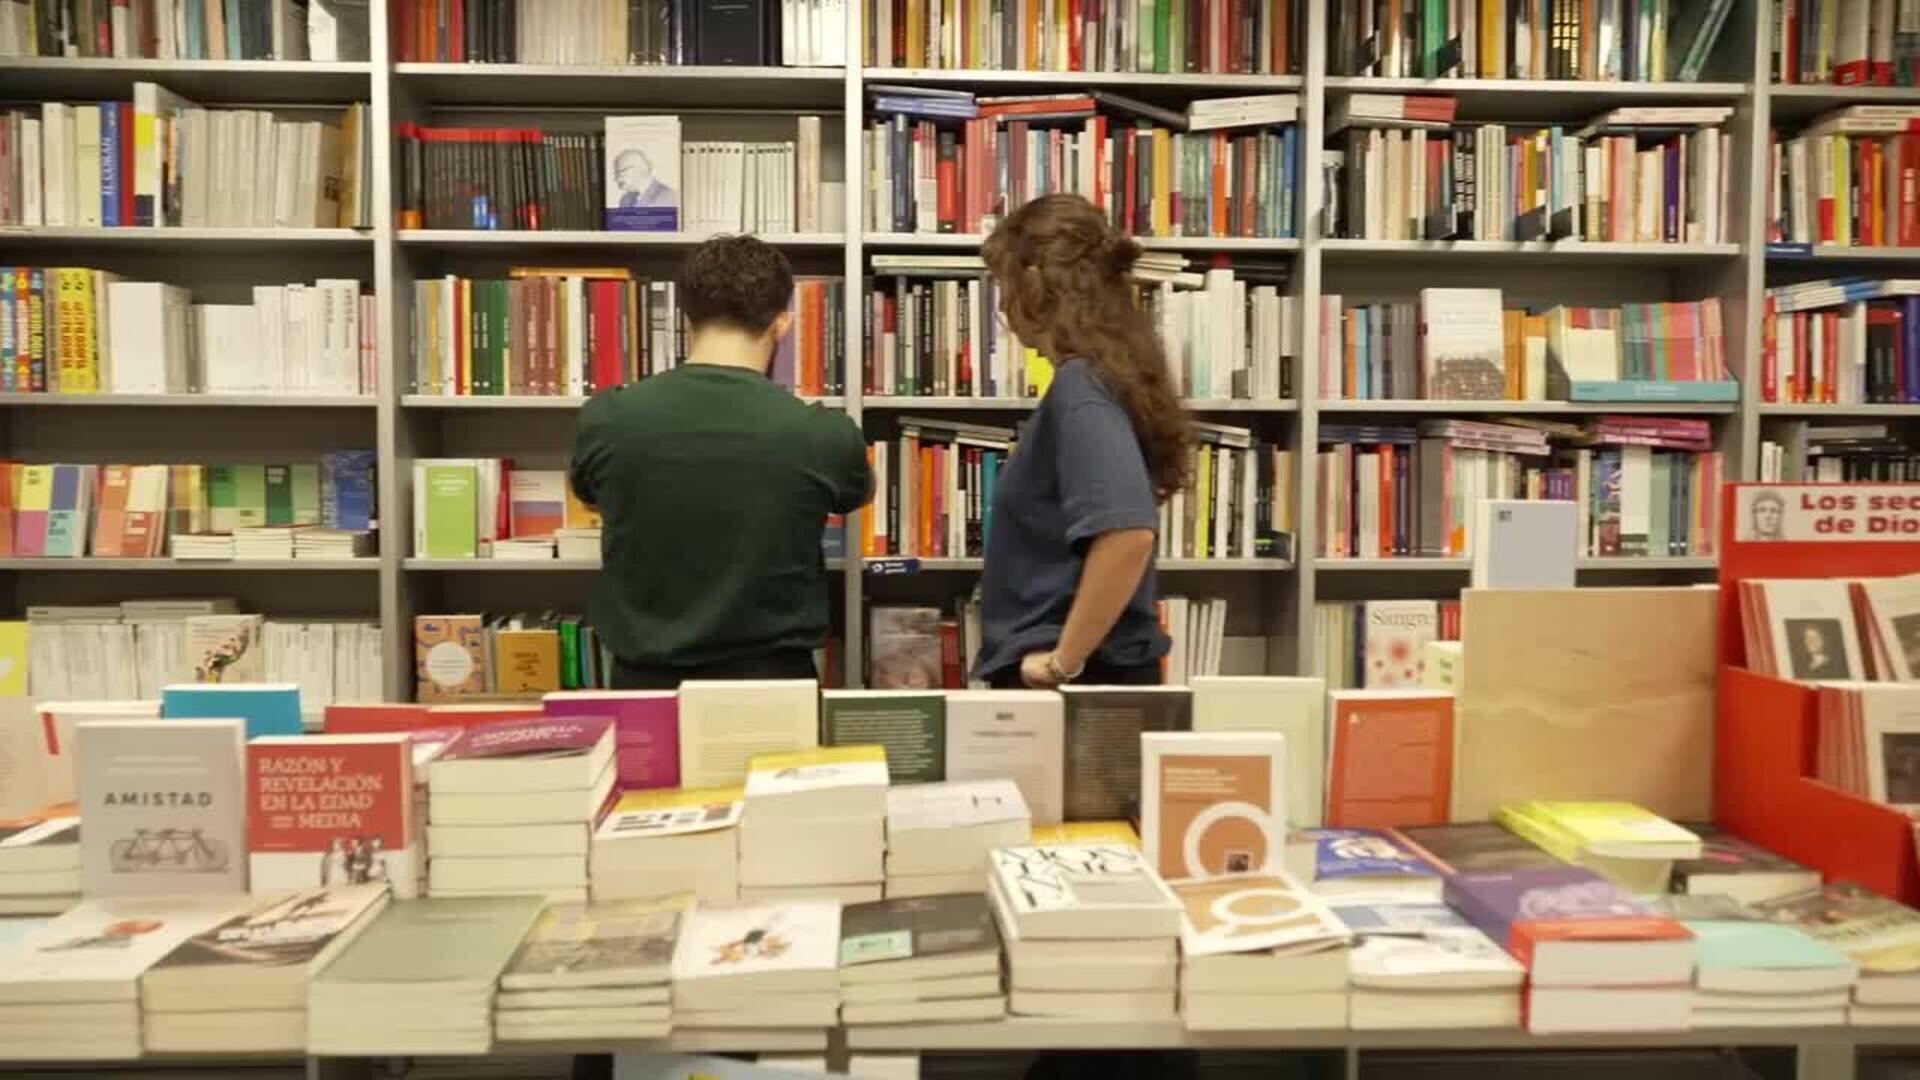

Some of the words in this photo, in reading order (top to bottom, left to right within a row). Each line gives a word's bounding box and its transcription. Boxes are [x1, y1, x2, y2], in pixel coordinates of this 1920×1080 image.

[1800, 493, 1856, 510] Los
[1815, 516, 1855, 533] de
[258, 756, 327, 774] RAZÓN
[328, 756, 345, 772] Y
[259, 773, 383, 792] REVELACIÓN
[104, 791, 213, 807] AMISTAD
[260, 794, 287, 811] EN
[290, 794, 315, 811] LA
[319, 793, 373, 810] EDAD
[298, 812, 361, 828] MEDIA
